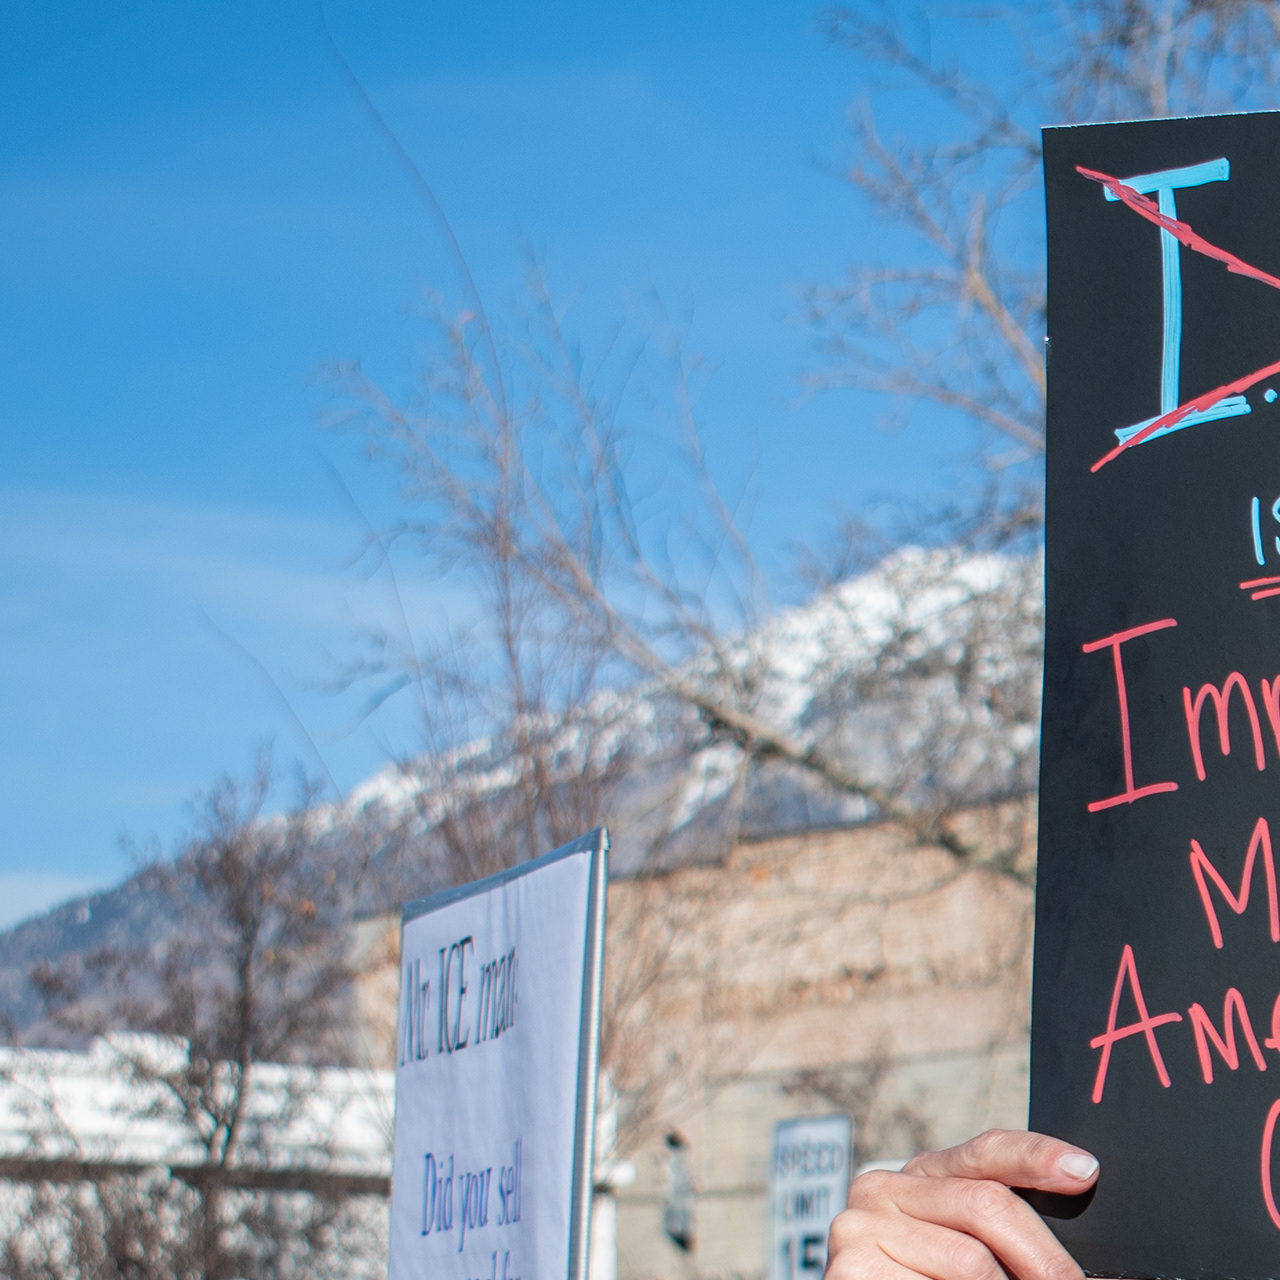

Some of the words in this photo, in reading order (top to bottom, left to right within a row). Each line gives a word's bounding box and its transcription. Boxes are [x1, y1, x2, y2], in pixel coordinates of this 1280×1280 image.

[437, 934, 475, 1055] ICE
[420, 1153, 455, 1237] Did
[458, 1167, 493, 1253] you
[497, 1137, 523, 1227] sell
